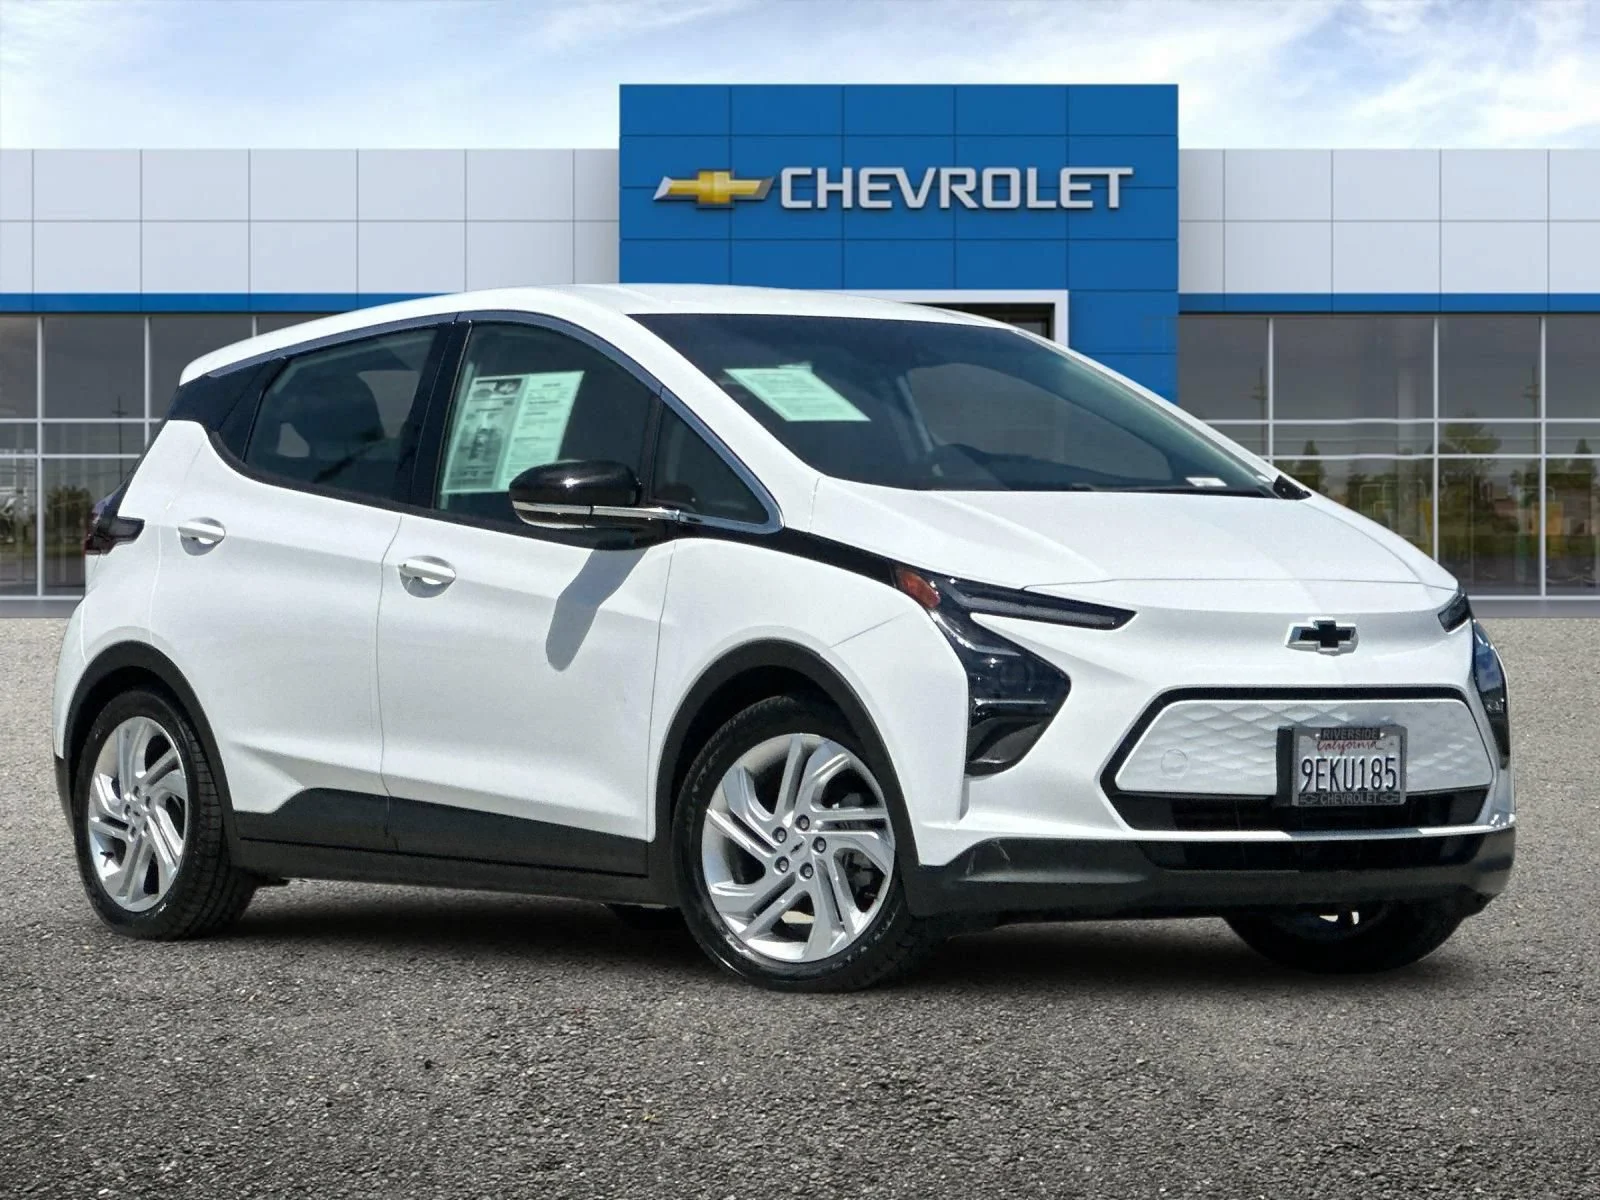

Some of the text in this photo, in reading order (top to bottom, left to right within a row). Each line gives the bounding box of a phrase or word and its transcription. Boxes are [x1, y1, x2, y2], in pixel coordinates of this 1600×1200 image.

[781, 167, 1133, 209] CHEVROLET
[1322, 728, 1378, 739] RIVERSIDE
[1317, 740, 1379, 755] California
[1301, 757, 1397, 792] 9EKU185
[1320, 793, 1378, 804] CHEVROLET
